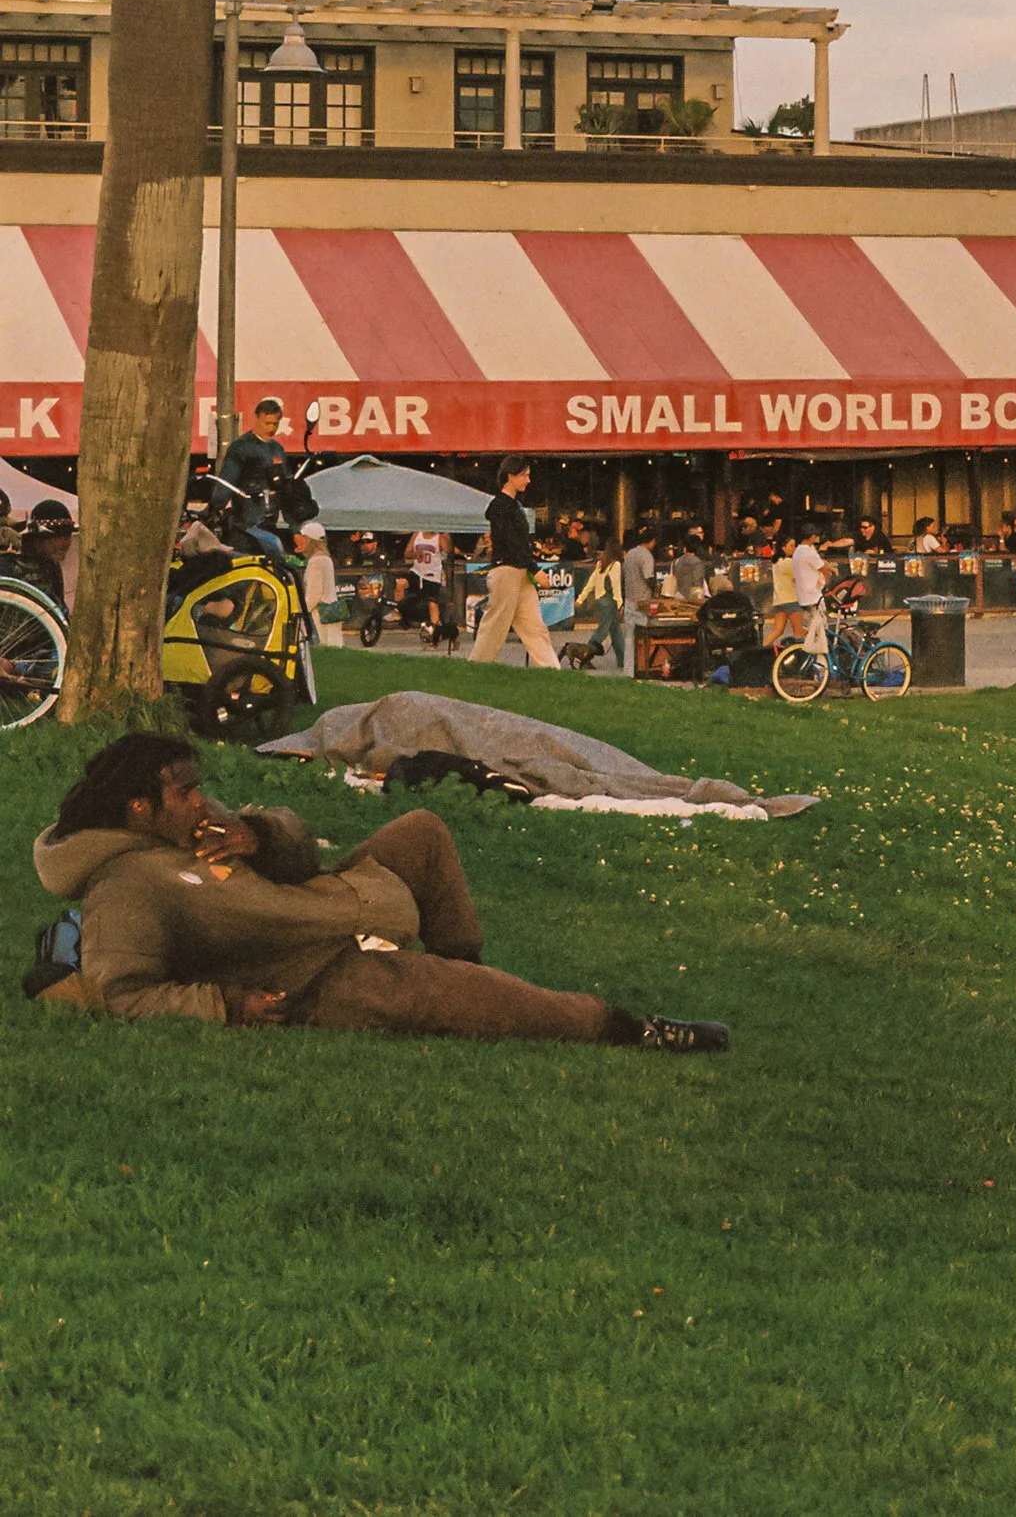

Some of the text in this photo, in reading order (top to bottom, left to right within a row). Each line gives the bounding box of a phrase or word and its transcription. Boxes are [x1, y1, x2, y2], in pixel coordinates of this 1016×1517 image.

[317, 396, 432, 436] BAR
[565, 394, 743, 434] SMALL
[759, 393, 942, 432] WORLD
